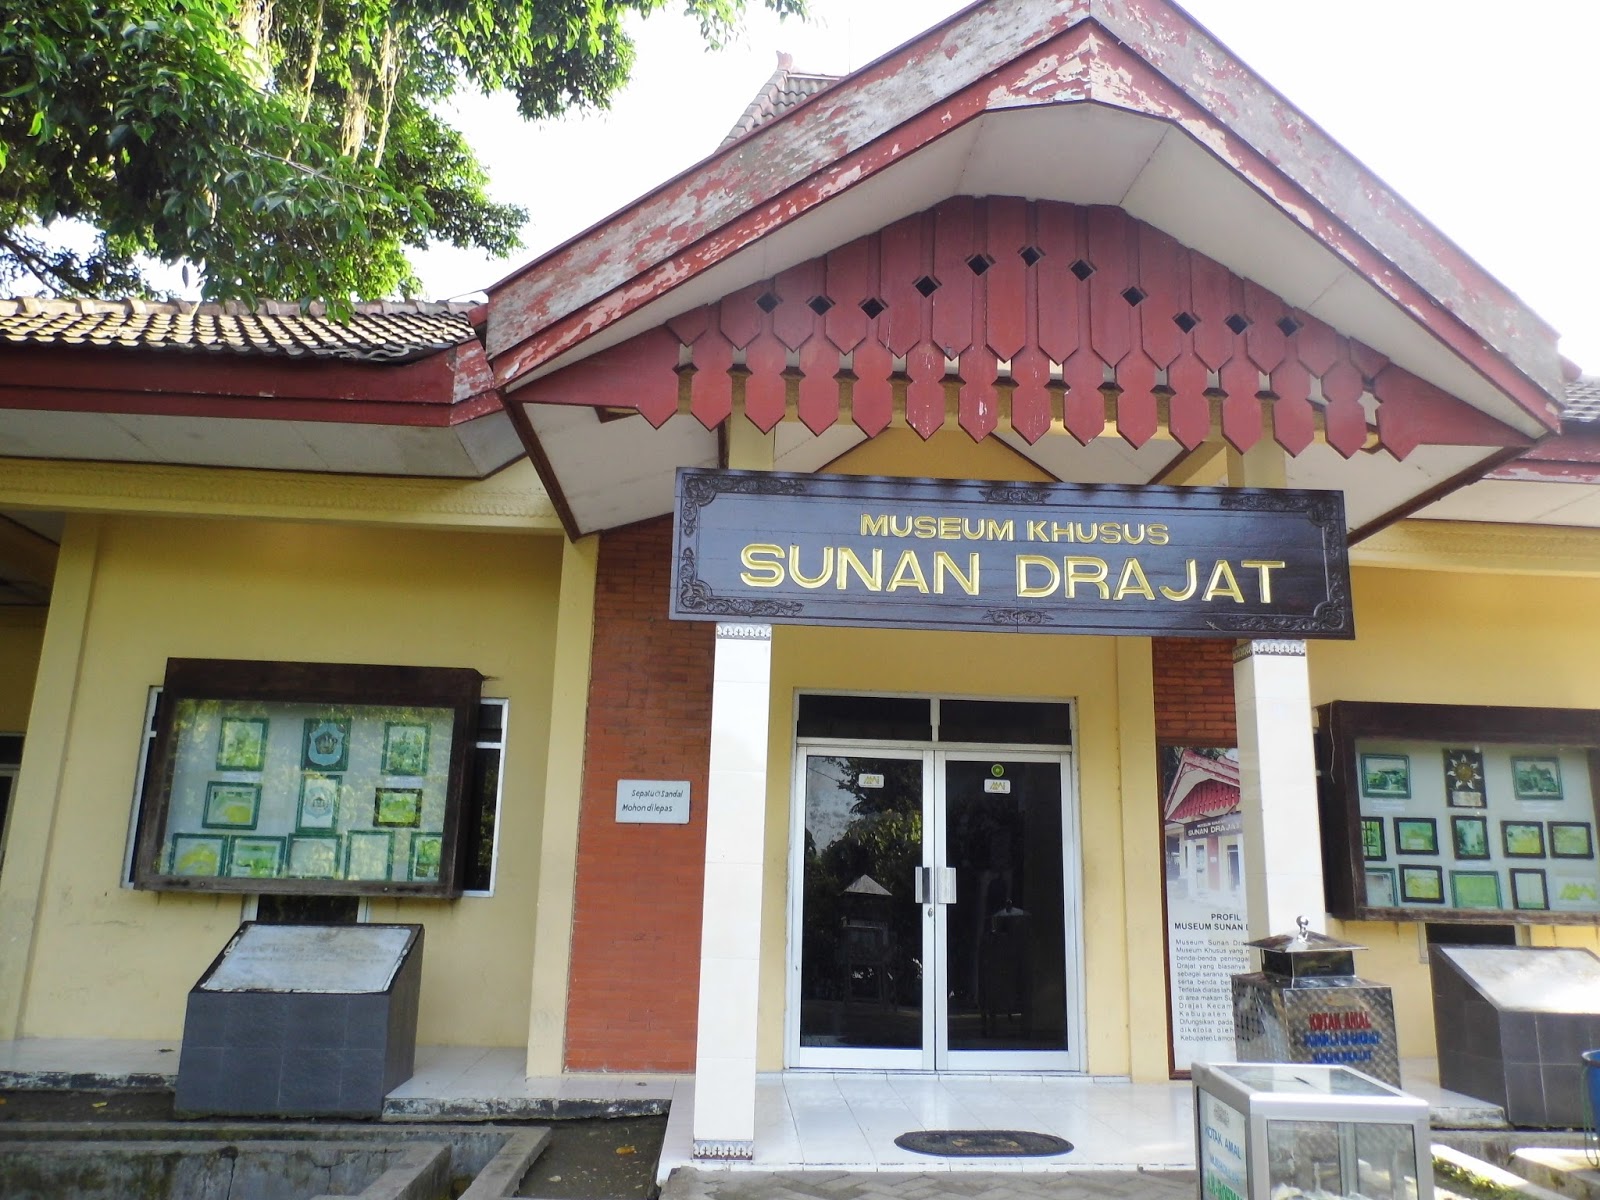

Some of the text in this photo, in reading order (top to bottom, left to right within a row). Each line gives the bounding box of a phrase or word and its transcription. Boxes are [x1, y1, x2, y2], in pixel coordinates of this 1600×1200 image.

[860, 513, 1170, 545] MUSEUM KHUSUS
[740, 543, 1286, 604] SUNAN DRAJAT
[631, 789, 654, 799] Sepatu
[660, 790, 684, 798] Sandal
[622, 803, 672, 814] Mohon dilepas
[1210, 913, 1242, 921] PROFIL
[1174, 922, 1212, 930] MUSEUM
[1214, 923, 1244, 931] SUNAN
